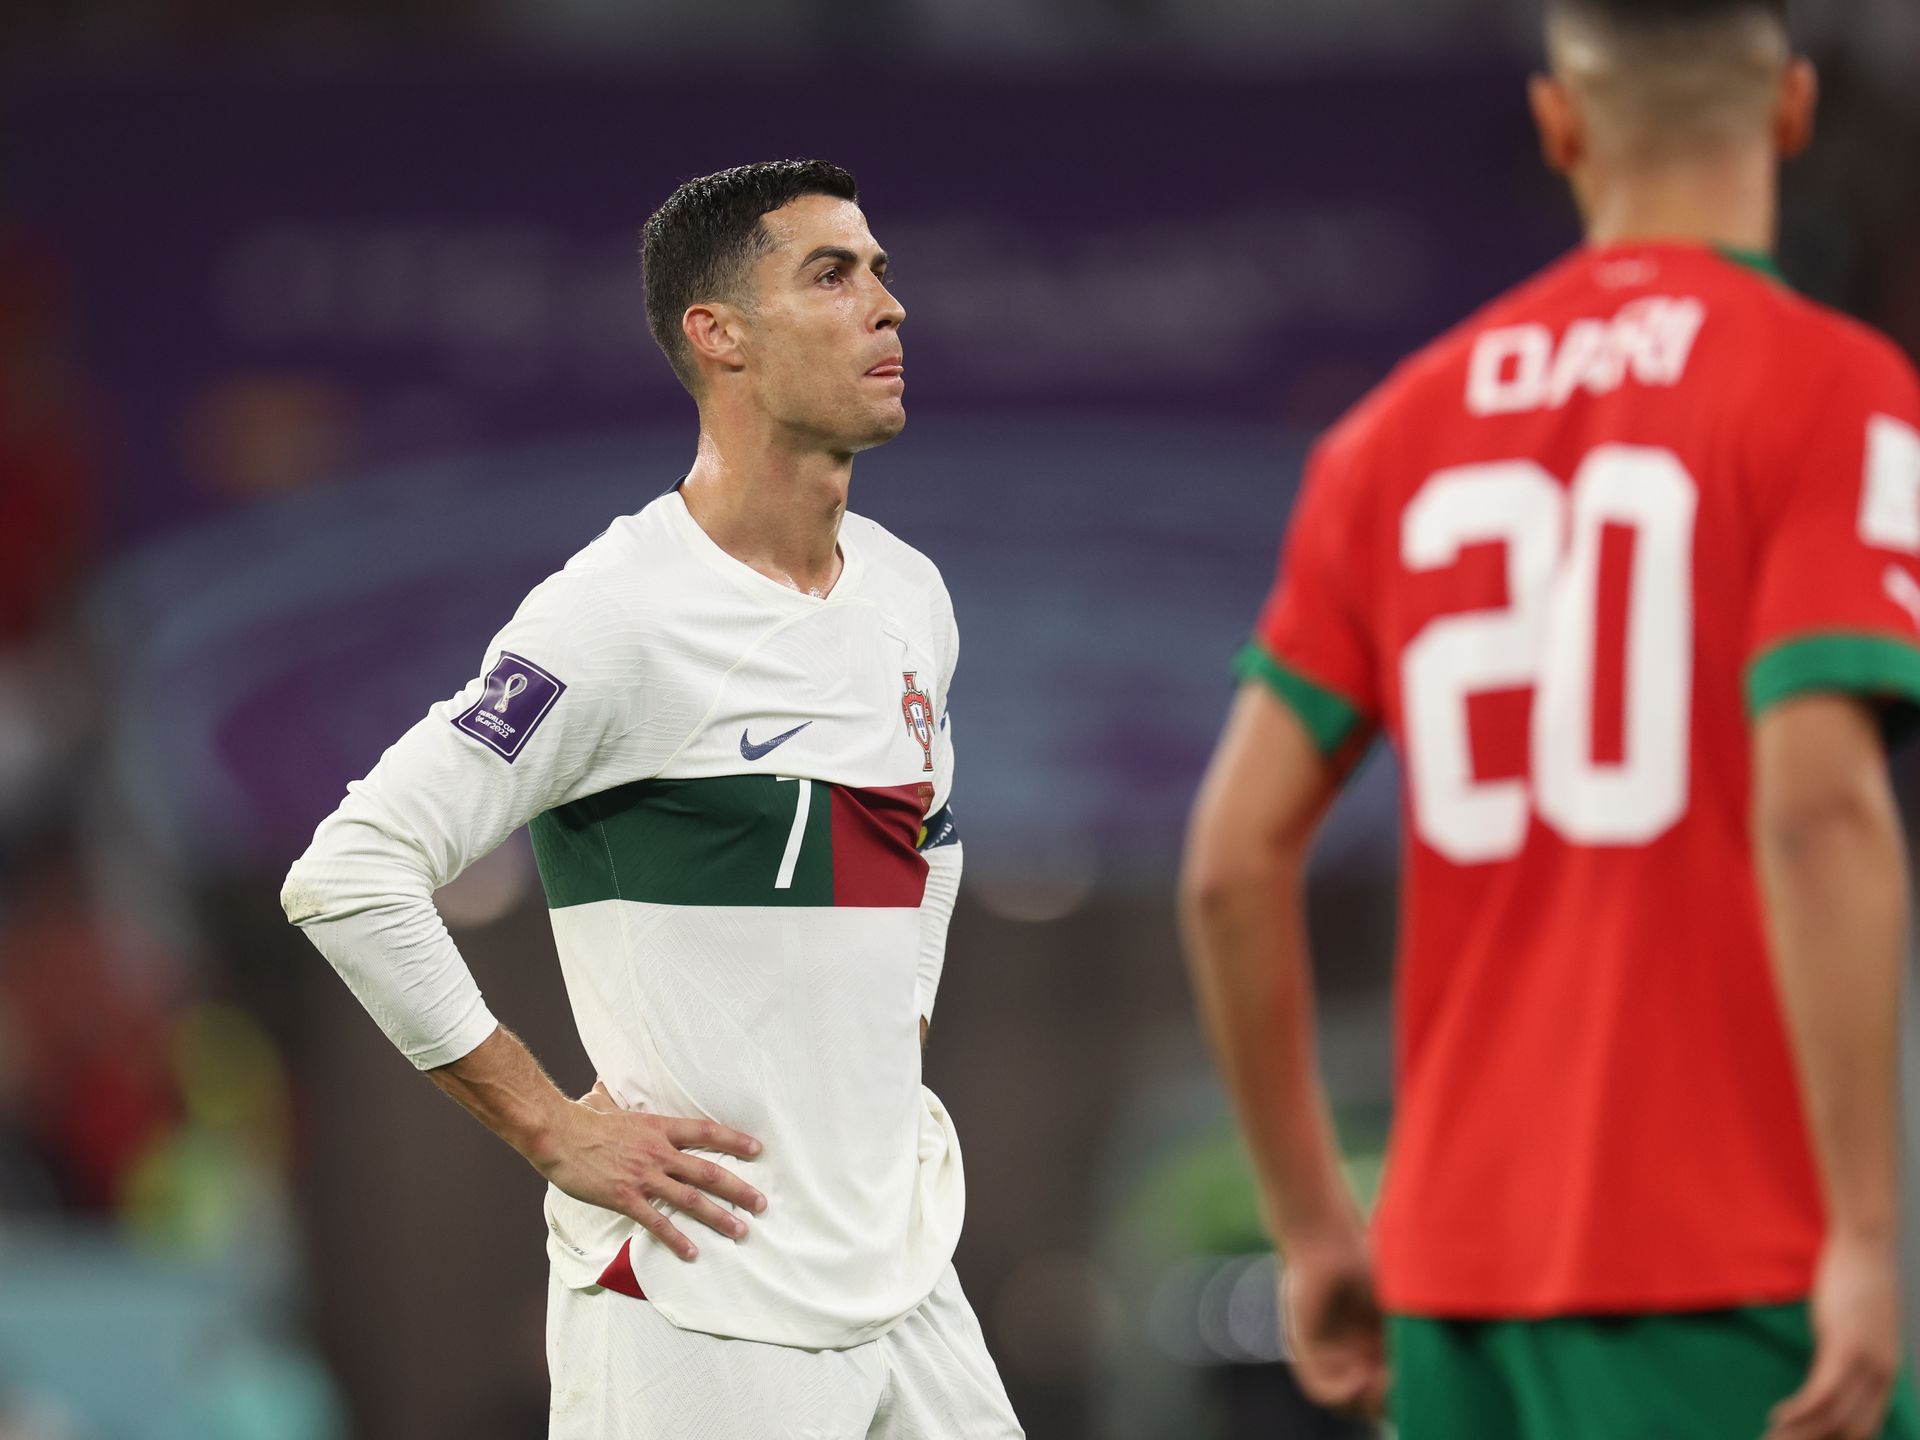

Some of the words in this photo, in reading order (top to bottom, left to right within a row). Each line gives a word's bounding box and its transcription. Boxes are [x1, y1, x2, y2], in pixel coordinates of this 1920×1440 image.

[1465, 296, 1705, 416] DARI
[1401, 444, 1697, 865] 20
[503, 723, 516, 734] CUP
[774, 777, 811, 888] 7
